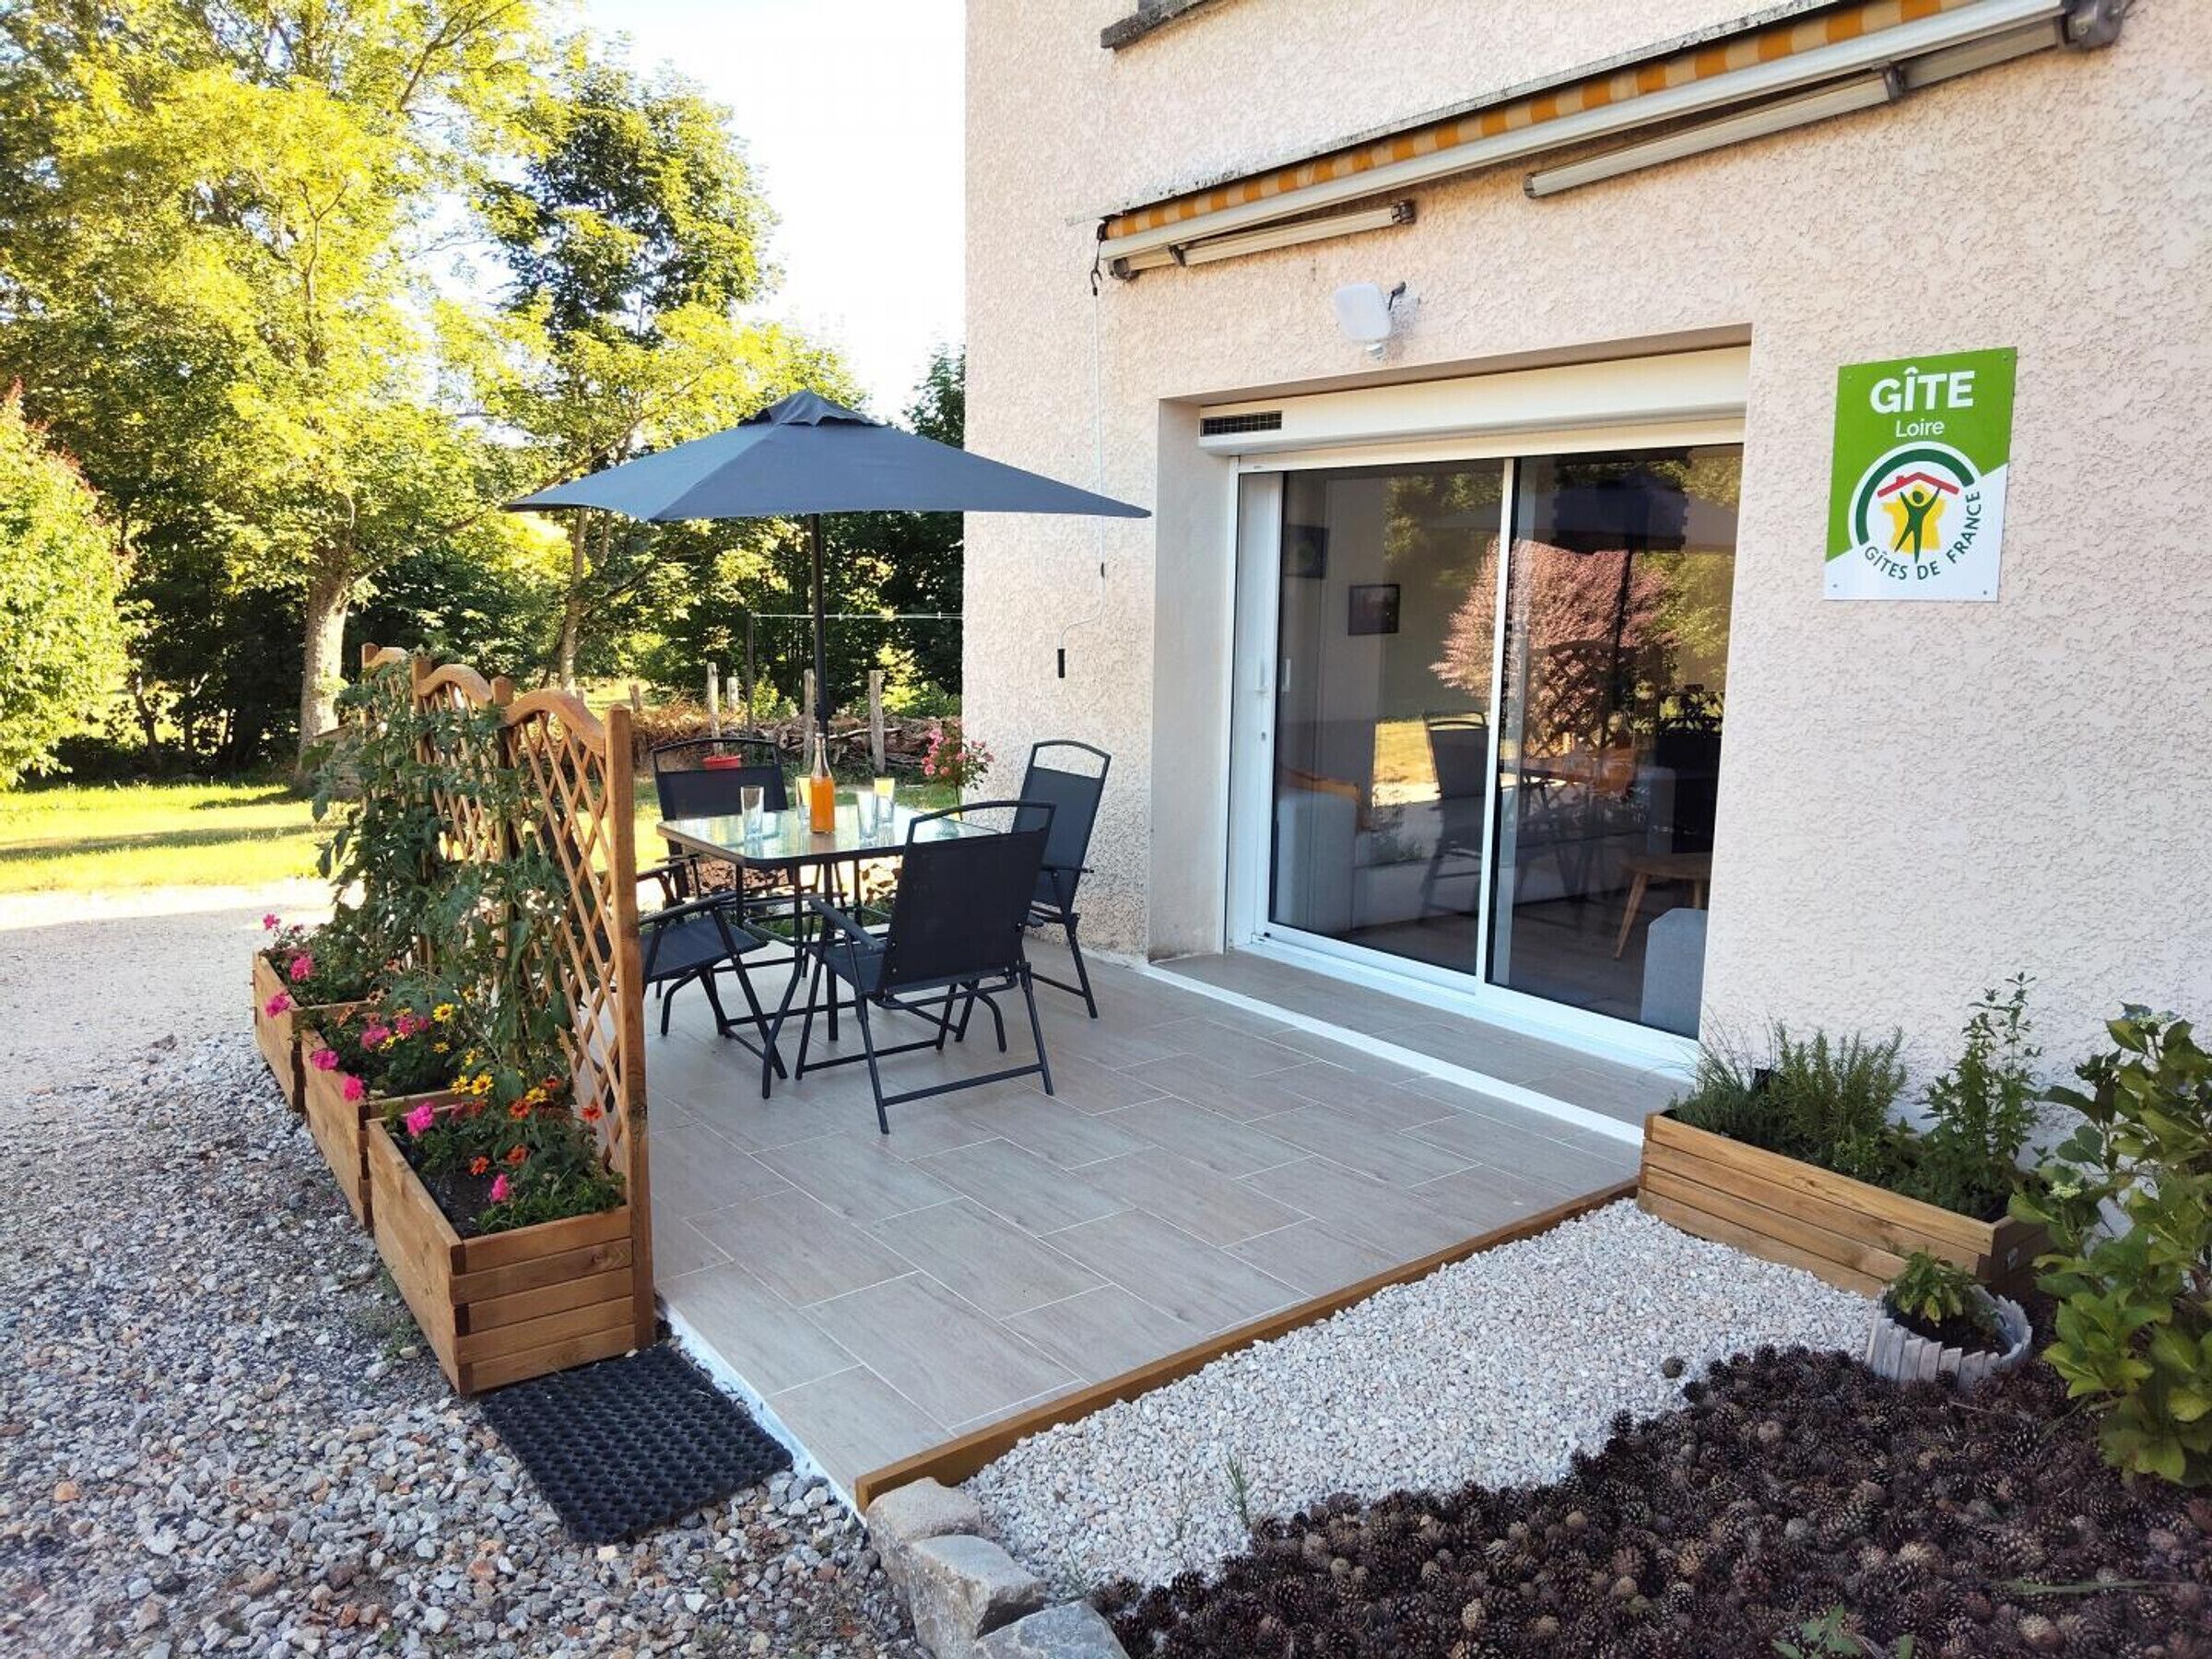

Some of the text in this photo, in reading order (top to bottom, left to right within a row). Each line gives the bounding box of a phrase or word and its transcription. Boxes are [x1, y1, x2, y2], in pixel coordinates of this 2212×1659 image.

[1870, 366, 1975, 414] GÎTE
[1895, 419, 1945, 438] Loire
[1917, 560, 1941, 581] DE
[1946, 490, 1981, 564] FRANCE
